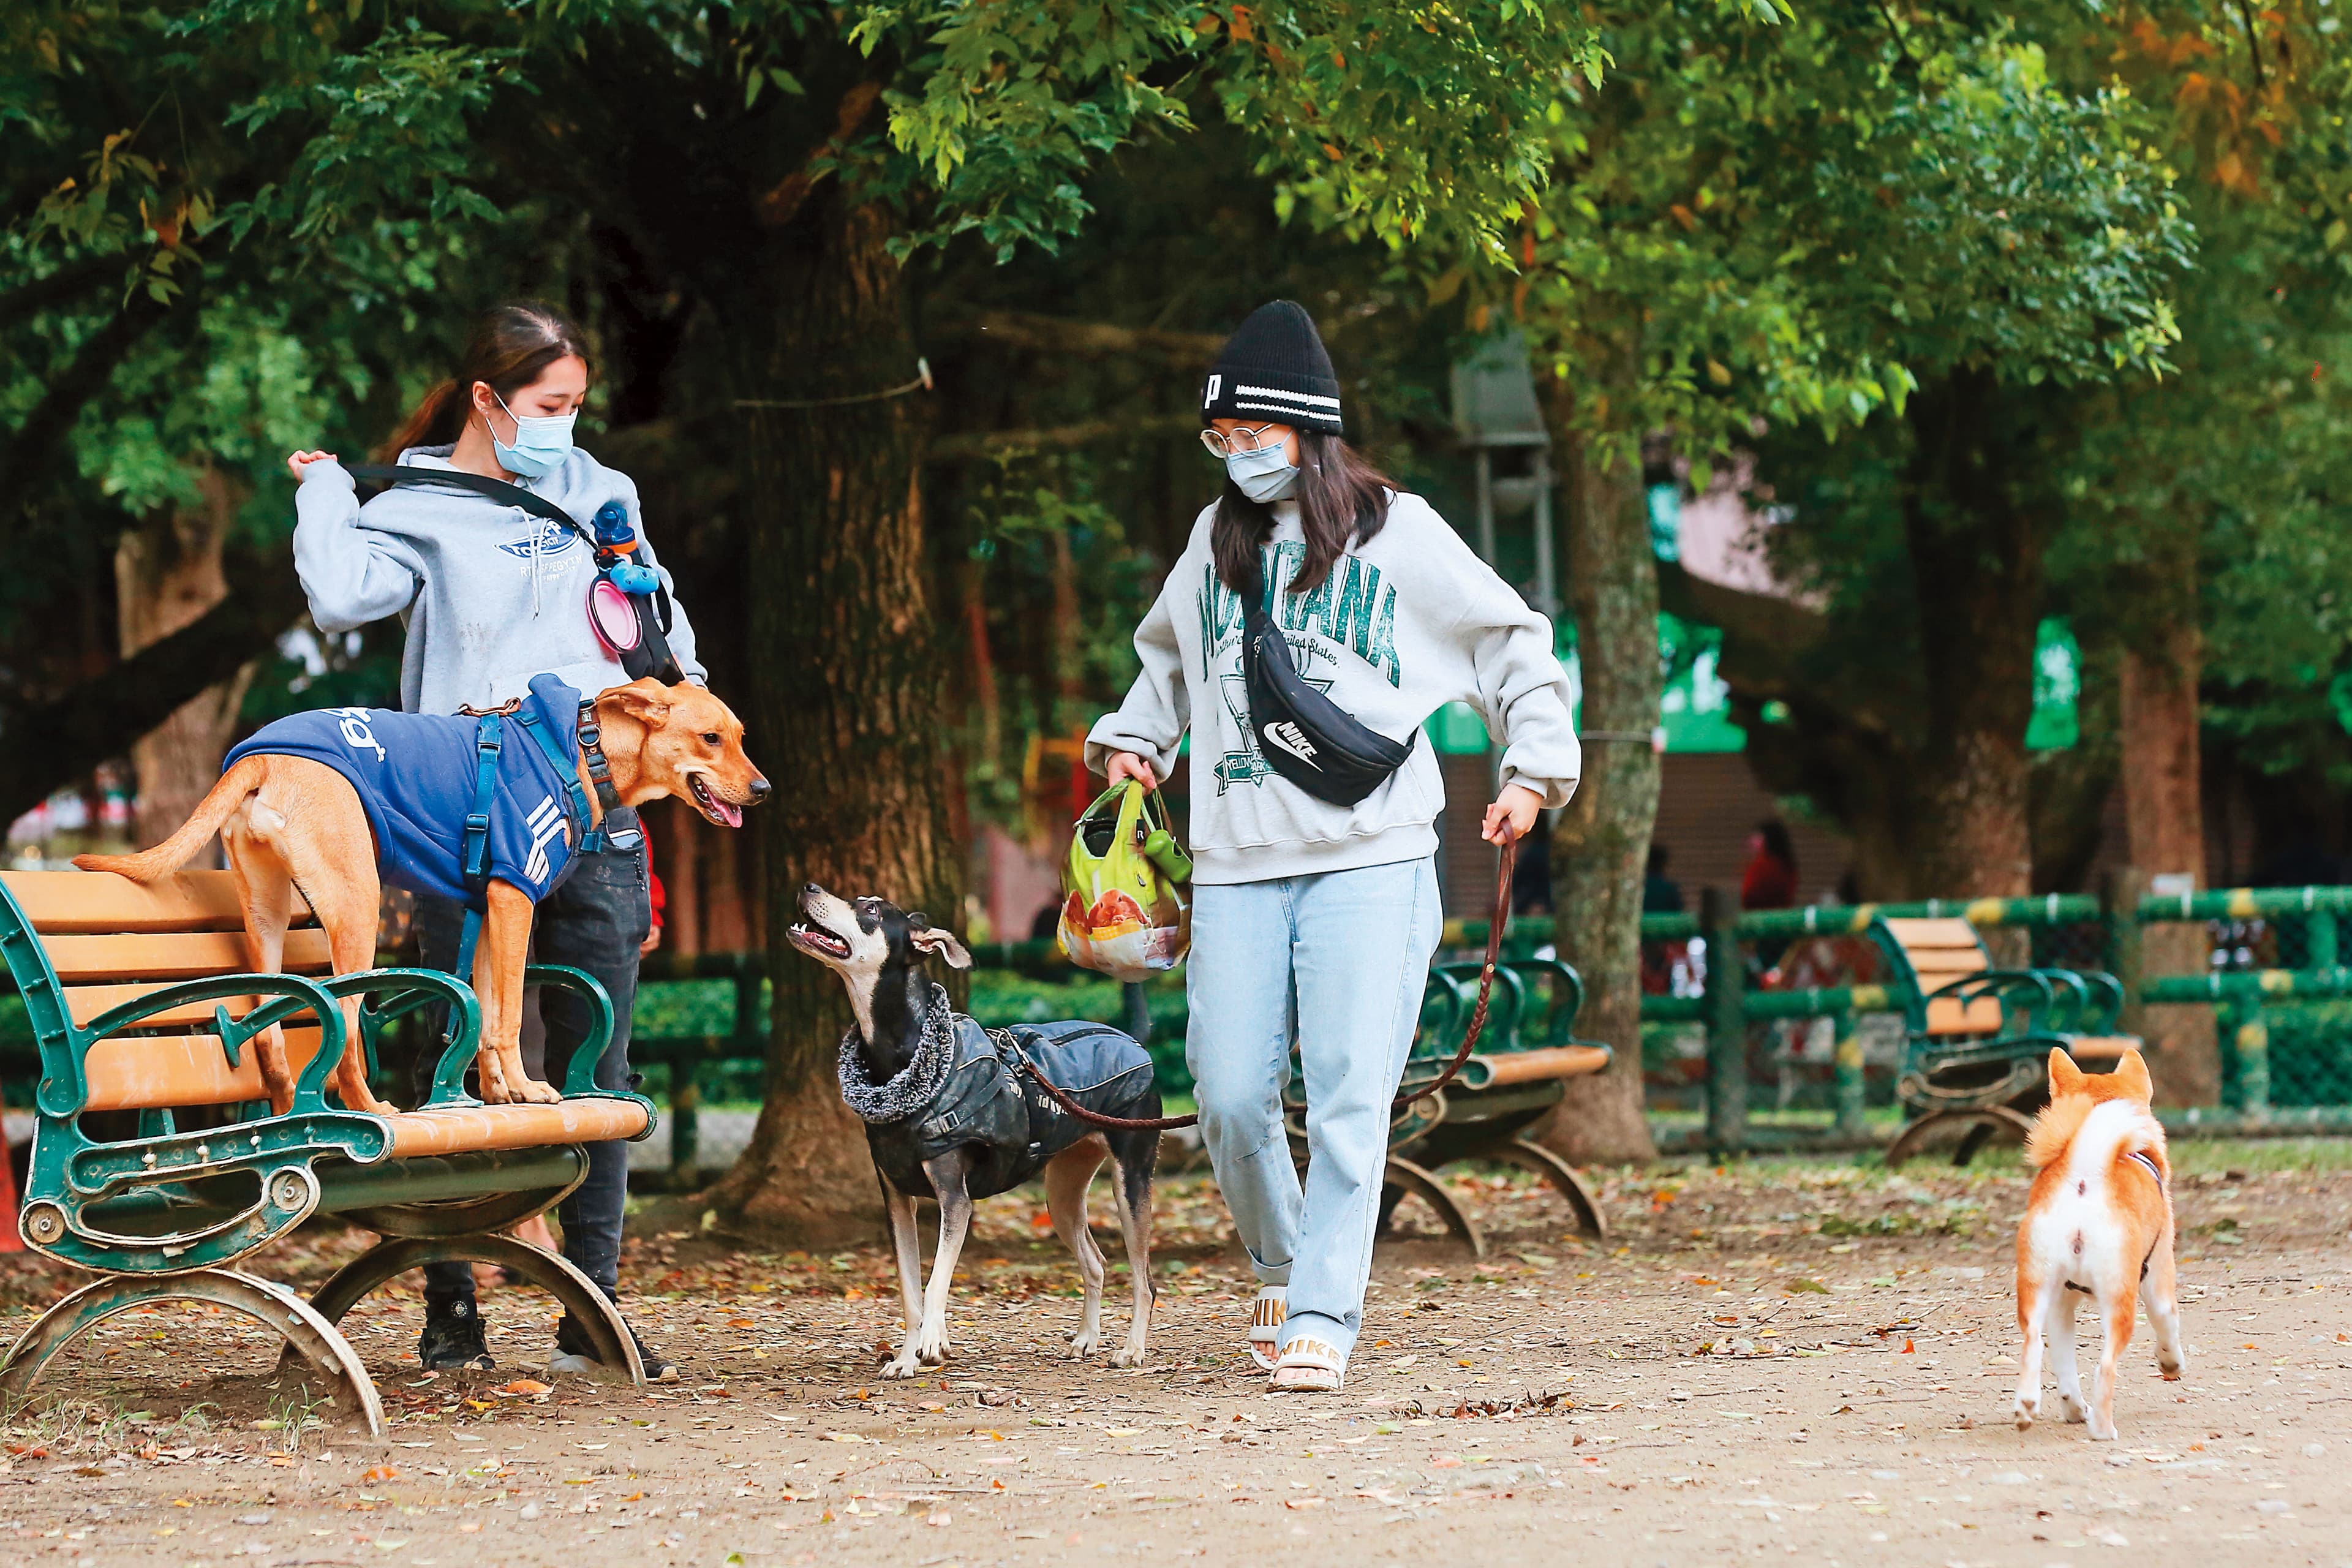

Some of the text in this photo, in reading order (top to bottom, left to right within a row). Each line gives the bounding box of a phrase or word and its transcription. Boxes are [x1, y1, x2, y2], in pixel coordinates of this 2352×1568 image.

[1204, 374, 1221, 409] P
[1277, 721, 1317, 758] NIKE
[1253, 1298, 1286, 1326] NIK
[1280, 1340, 1340, 1365] NIKE
